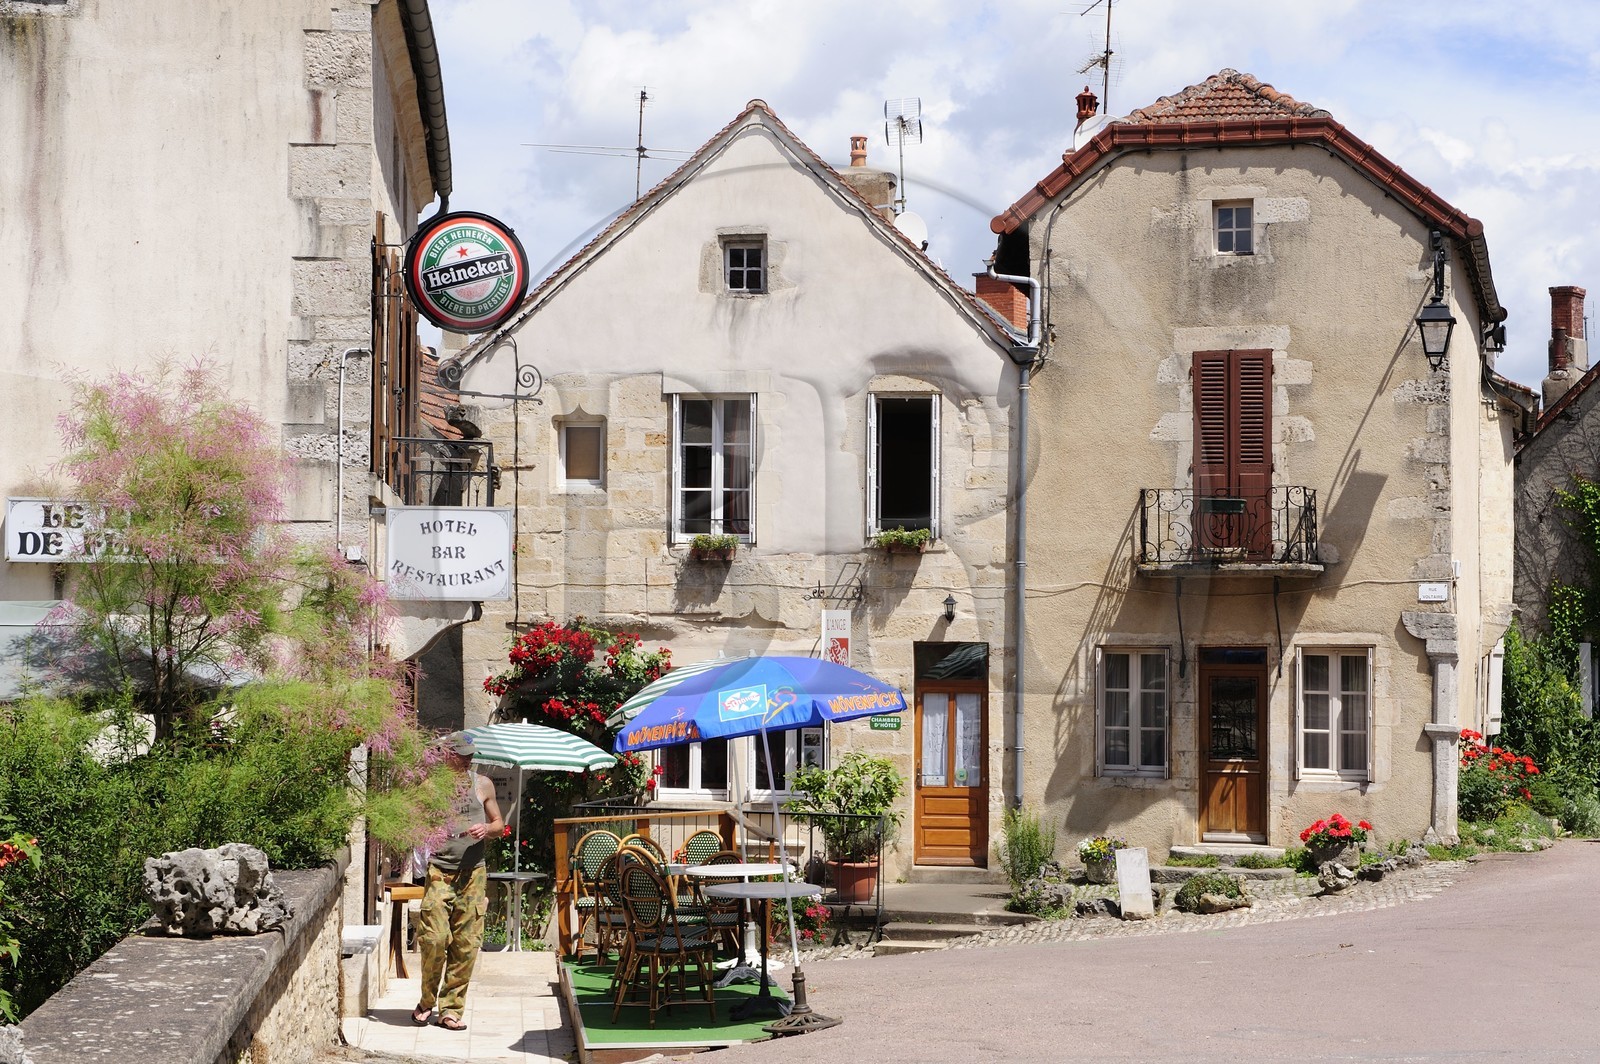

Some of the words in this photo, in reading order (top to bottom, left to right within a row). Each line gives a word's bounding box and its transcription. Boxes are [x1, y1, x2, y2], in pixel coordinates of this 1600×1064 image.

[429, 237, 449, 258] BIERE
[451, 230, 493, 245] HEINEKEN
[428, 258, 508, 288] Heineken
[440, 297, 463, 312] BIERE
[466, 306, 476, 314] DE
[478, 281, 508, 312] PRESTIGE
[42, 505, 83, 528] LE
[420, 520, 477, 536] HOTEL
[18, 532, 63, 555] DE
[432, 546, 466, 559] BAR
[391, 560, 505, 586] RESTAURANT
[826, 619, 846, 631] L'ANGE
[828, 691, 900, 713] MÖVENPICK
